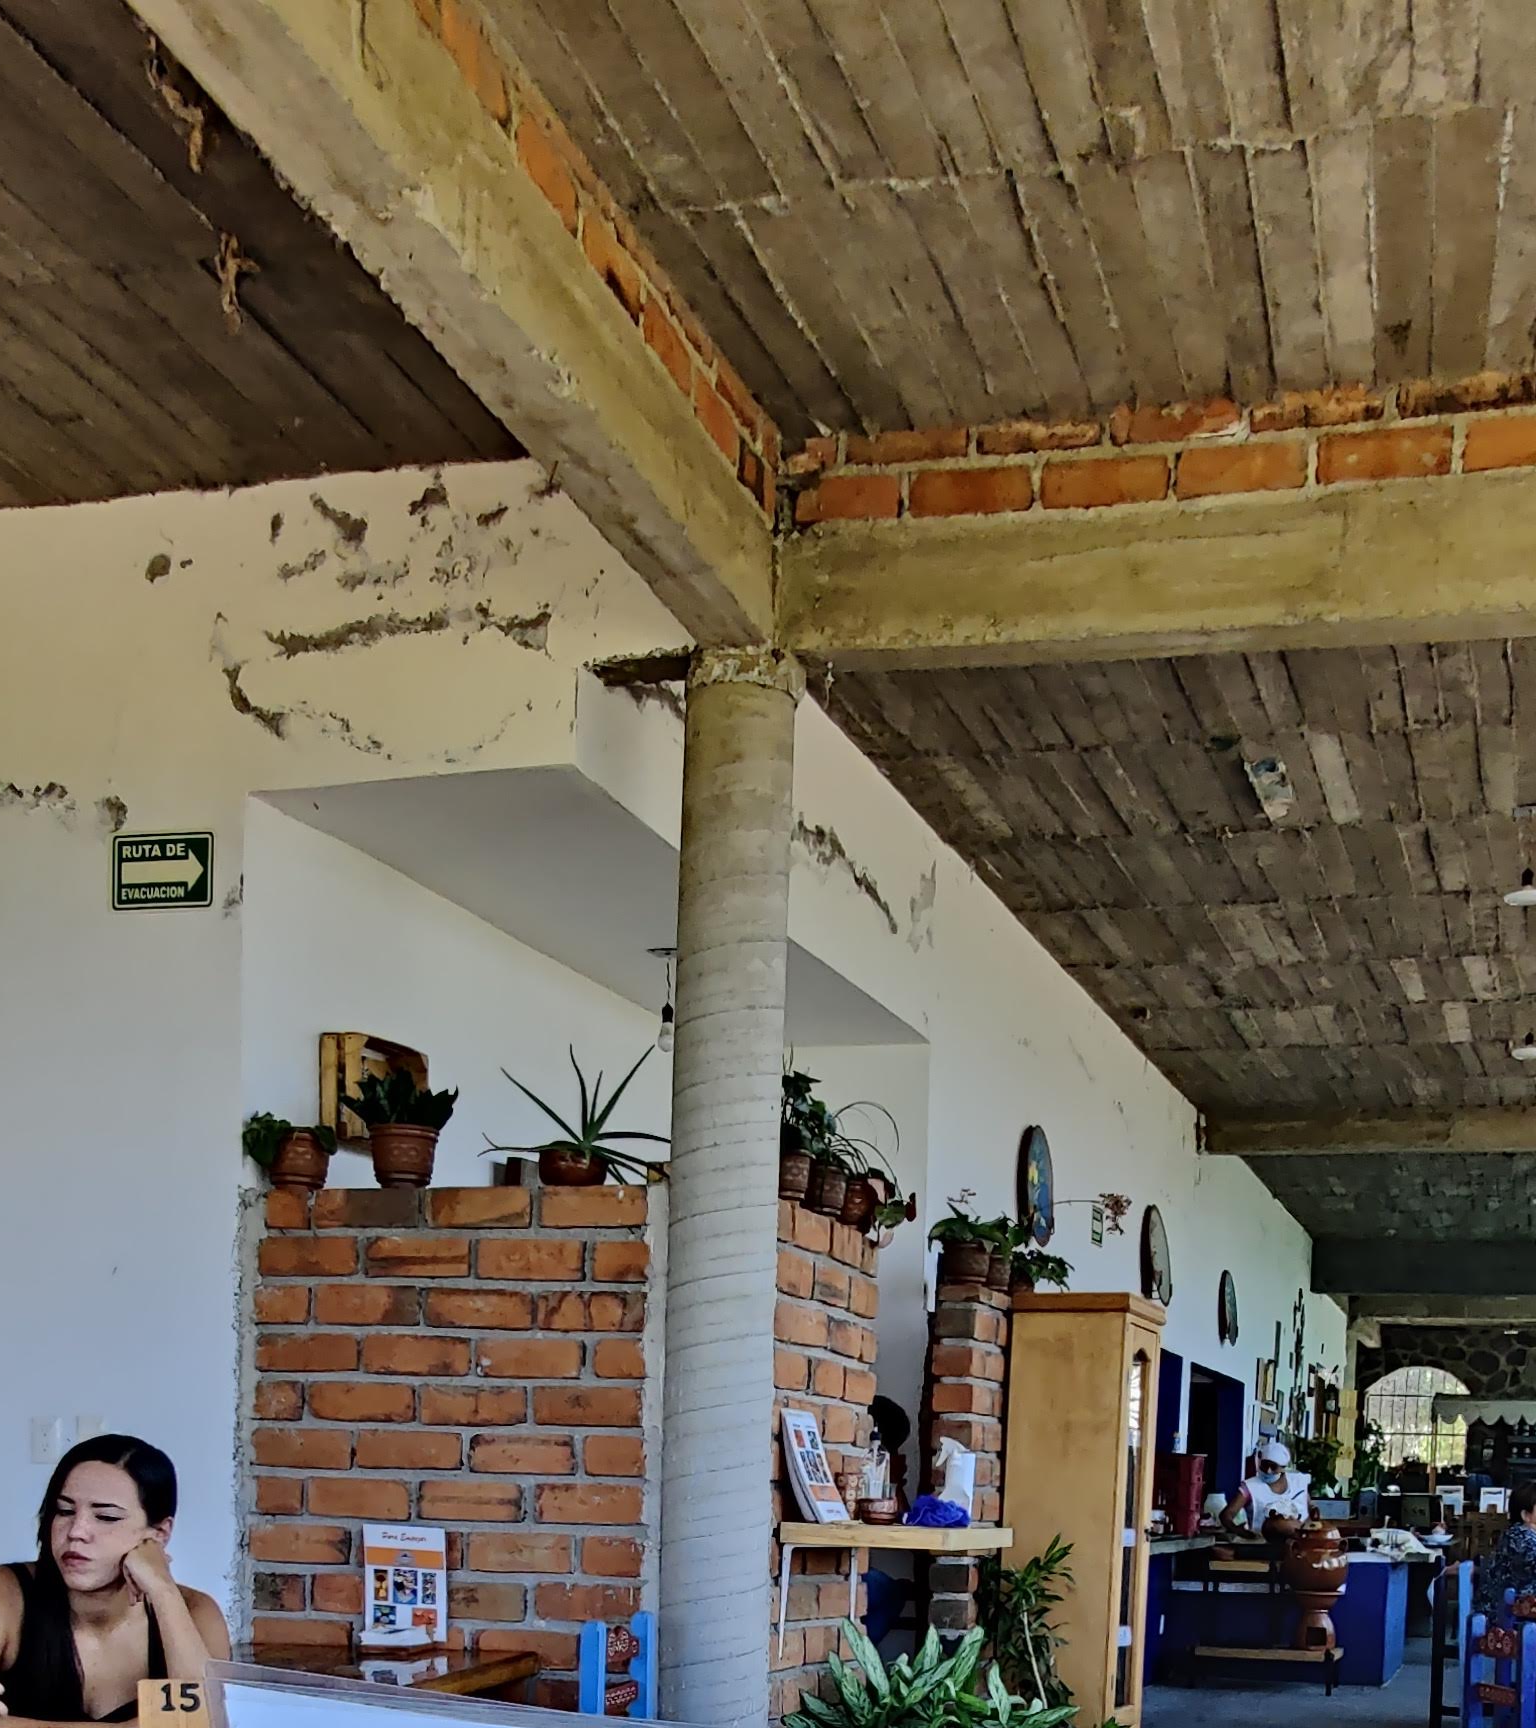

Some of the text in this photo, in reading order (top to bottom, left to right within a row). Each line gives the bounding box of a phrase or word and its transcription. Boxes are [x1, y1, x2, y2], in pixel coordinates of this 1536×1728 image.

[122, 843, 186, 858] RUTA DE
[121, 886, 185, 900] EVACUACION
[161, 1683, 201, 1712] 15
